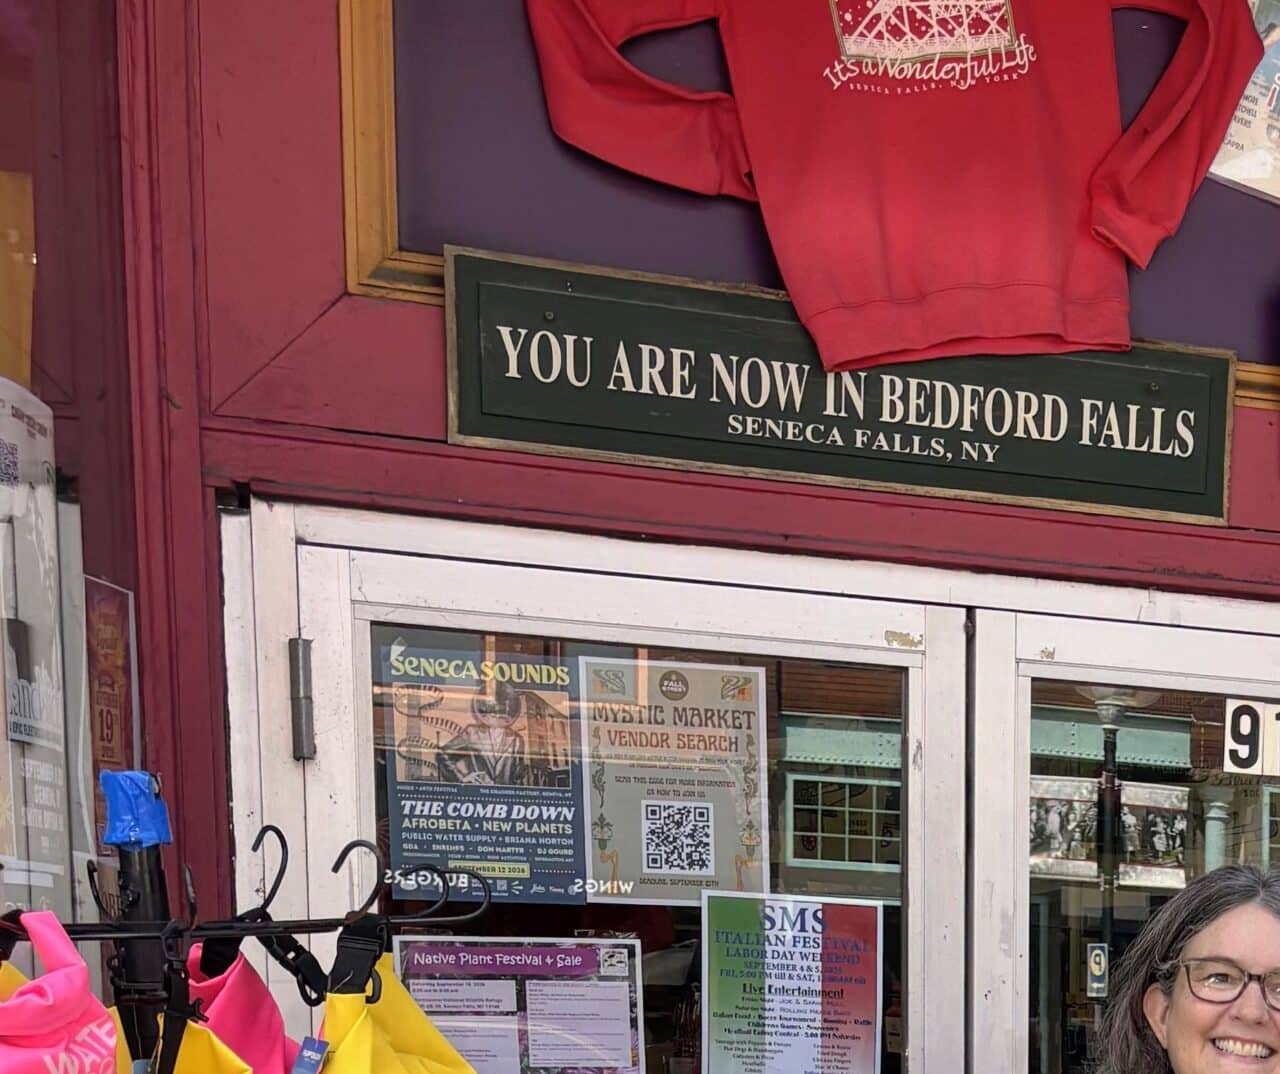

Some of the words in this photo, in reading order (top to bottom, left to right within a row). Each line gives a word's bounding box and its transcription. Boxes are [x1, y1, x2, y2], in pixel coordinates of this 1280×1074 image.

[877, 48, 999, 90] Wonderful
[1000, 33, 1037, 74] Life
[496, 325, 593, 388] YOU
[607, 340, 697, 399] ARE
[710, 352, 810, 413] NOW
[823, 370, 868, 420] IN
[879, 374, 1068, 442] BEDFORD
[1078, 398, 1195, 458] FALLS
[728, 415, 845, 447] SENECA
[854, 429, 953, 463] FALLS,
[961, 441, 1001, 464] NY
[593, 704, 665, 724] MYSTIC
[673, 706, 756, 730] MARKET
[607, 730, 671, 749] VENDOR
[676, 733, 739, 752] SEARCH
[401, 800, 447, 816] THE
[447, 802, 507, 819] COMB
[510, 805, 576, 822] DOWN
[402, 818, 471, 831] AFROBETA
[482, 821, 513, 832] NEW
[516, 822, 572, 834] PLANETS
[761, 904, 828, 934] SMS
[715, 931, 786, 947] ITALIAN
[793, 935, 870, 954] FESTIVAL
[414, 952, 456, 965] Native
[459, 952, 493, 966] Plant
[495, 953, 542, 966] Festival
[557, 954, 582, 967] Sale
[726, 947, 768, 959] LABOR
[771, 950, 795, 961] DAY
[768, 985, 843, 999] Entertainment
